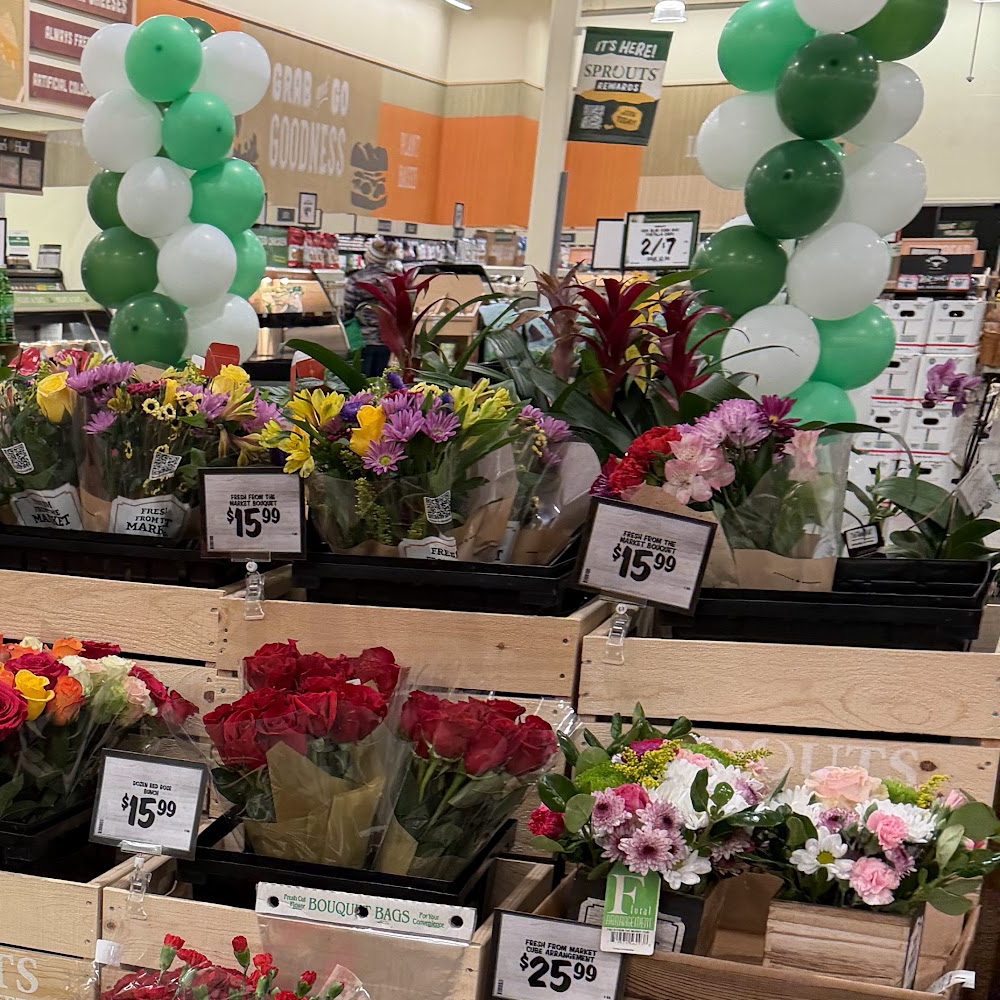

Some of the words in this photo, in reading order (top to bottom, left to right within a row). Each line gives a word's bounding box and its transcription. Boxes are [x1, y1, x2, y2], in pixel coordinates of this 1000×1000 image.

[595, 40, 618, 52] IT'S
[618, 40, 658, 58] HERE!
[584, 64, 658, 81] SPROUTS
[272, 63, 312, 108] GRAB
[331, 78, 349, 116] GO
[597, 81, 639, 92] REWARDS
[269, 113, 345, 177] GOODNESS
[620, 536, 645, 547] MARKET
[646, 542, 677, 554] BOUQUET
[623, 530, 642, 540] FRESH
[643, 534, 662, 544] FROM
[664, 539, 677, 548] THE
[133, 780, 148, 788] DOZEN
[283, 894, 297, 902] Fresh
[297, 895, 307, 903] Cut
[308, 898, 372, 917] BOUQU
[375, 906, 410, 924] BAGS
[525, 939, 546, 949] FRESH
[547, 942, 567, 952] FROM
[569, 946, 598, 957] MARKET
[526, 946, 542, 955] CUBE
[545, 949, 595, 963] ARRANGEMENT
